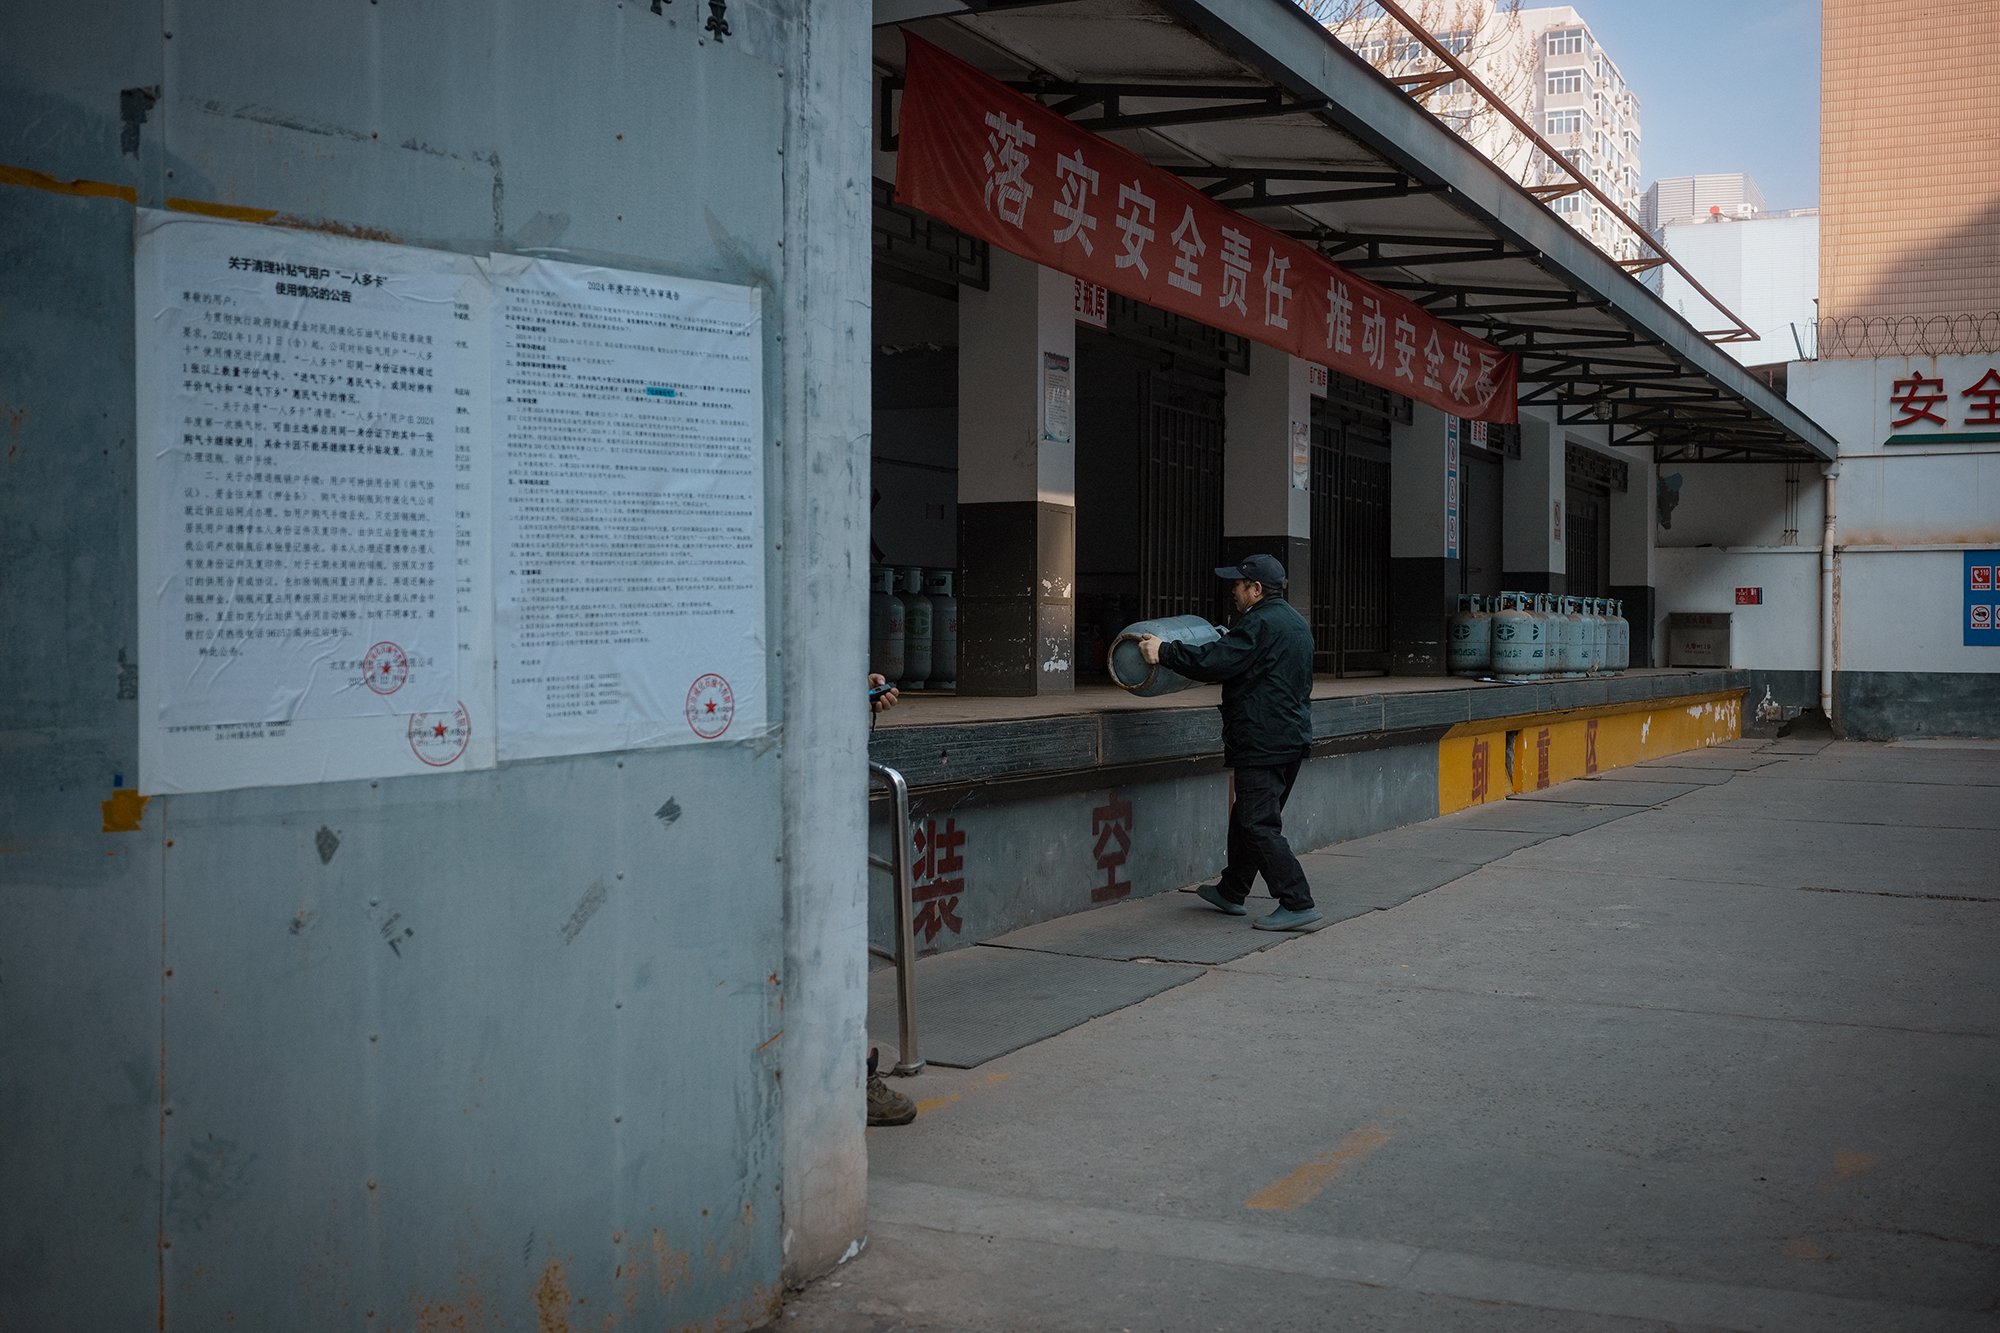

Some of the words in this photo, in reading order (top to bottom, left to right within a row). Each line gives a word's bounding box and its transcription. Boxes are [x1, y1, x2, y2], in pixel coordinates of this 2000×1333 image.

[275, 282, 352, 303] 使用情况的公告
[983, 111, 1293, 331] 落实安全责任
[1325, 275, 1497, 408] 推动安全发展
[1891, 368, 2000, 428] 安全
[1472, 719, 1599, 804] 卸重区
